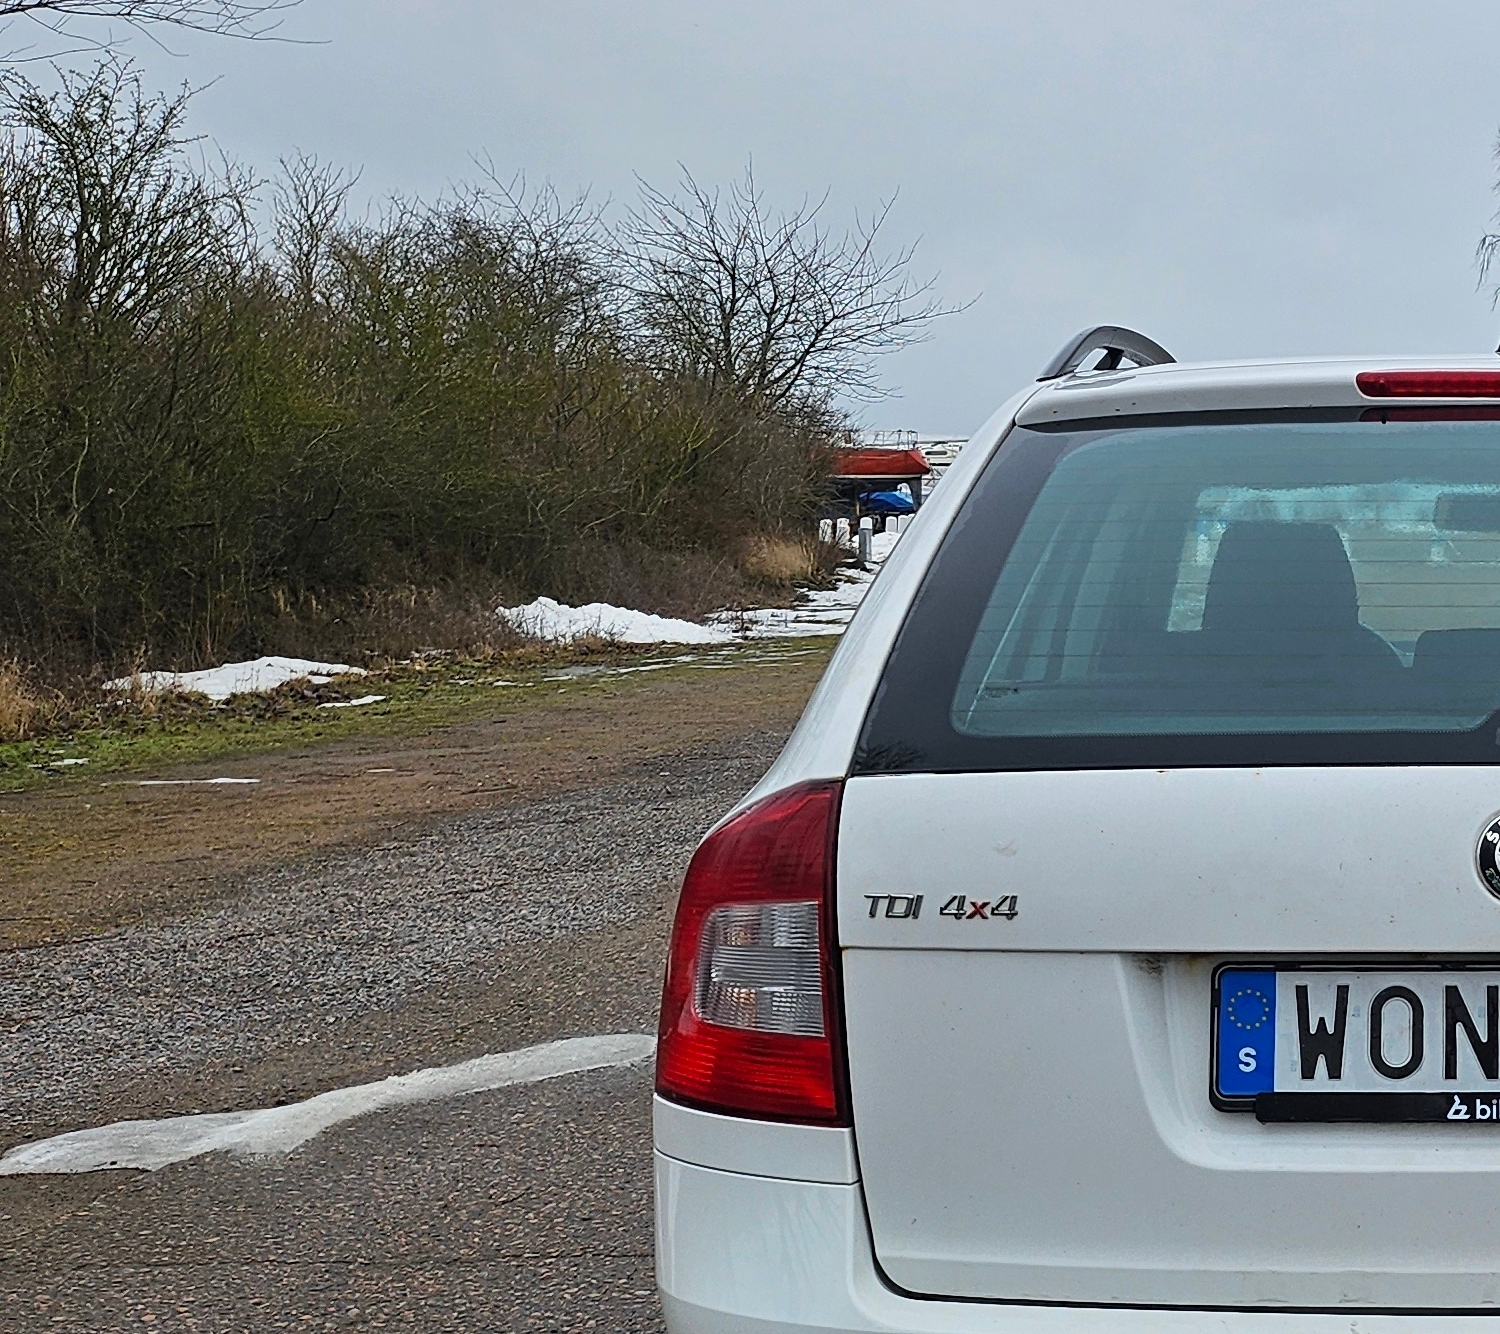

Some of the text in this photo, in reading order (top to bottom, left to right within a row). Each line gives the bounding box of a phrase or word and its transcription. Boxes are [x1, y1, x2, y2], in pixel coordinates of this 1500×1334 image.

[863, 893, 1019, 921] TDI 4x4
[1295, 984, 1500, 1081] WON
[1238, 1046, 1257, 1073] S
